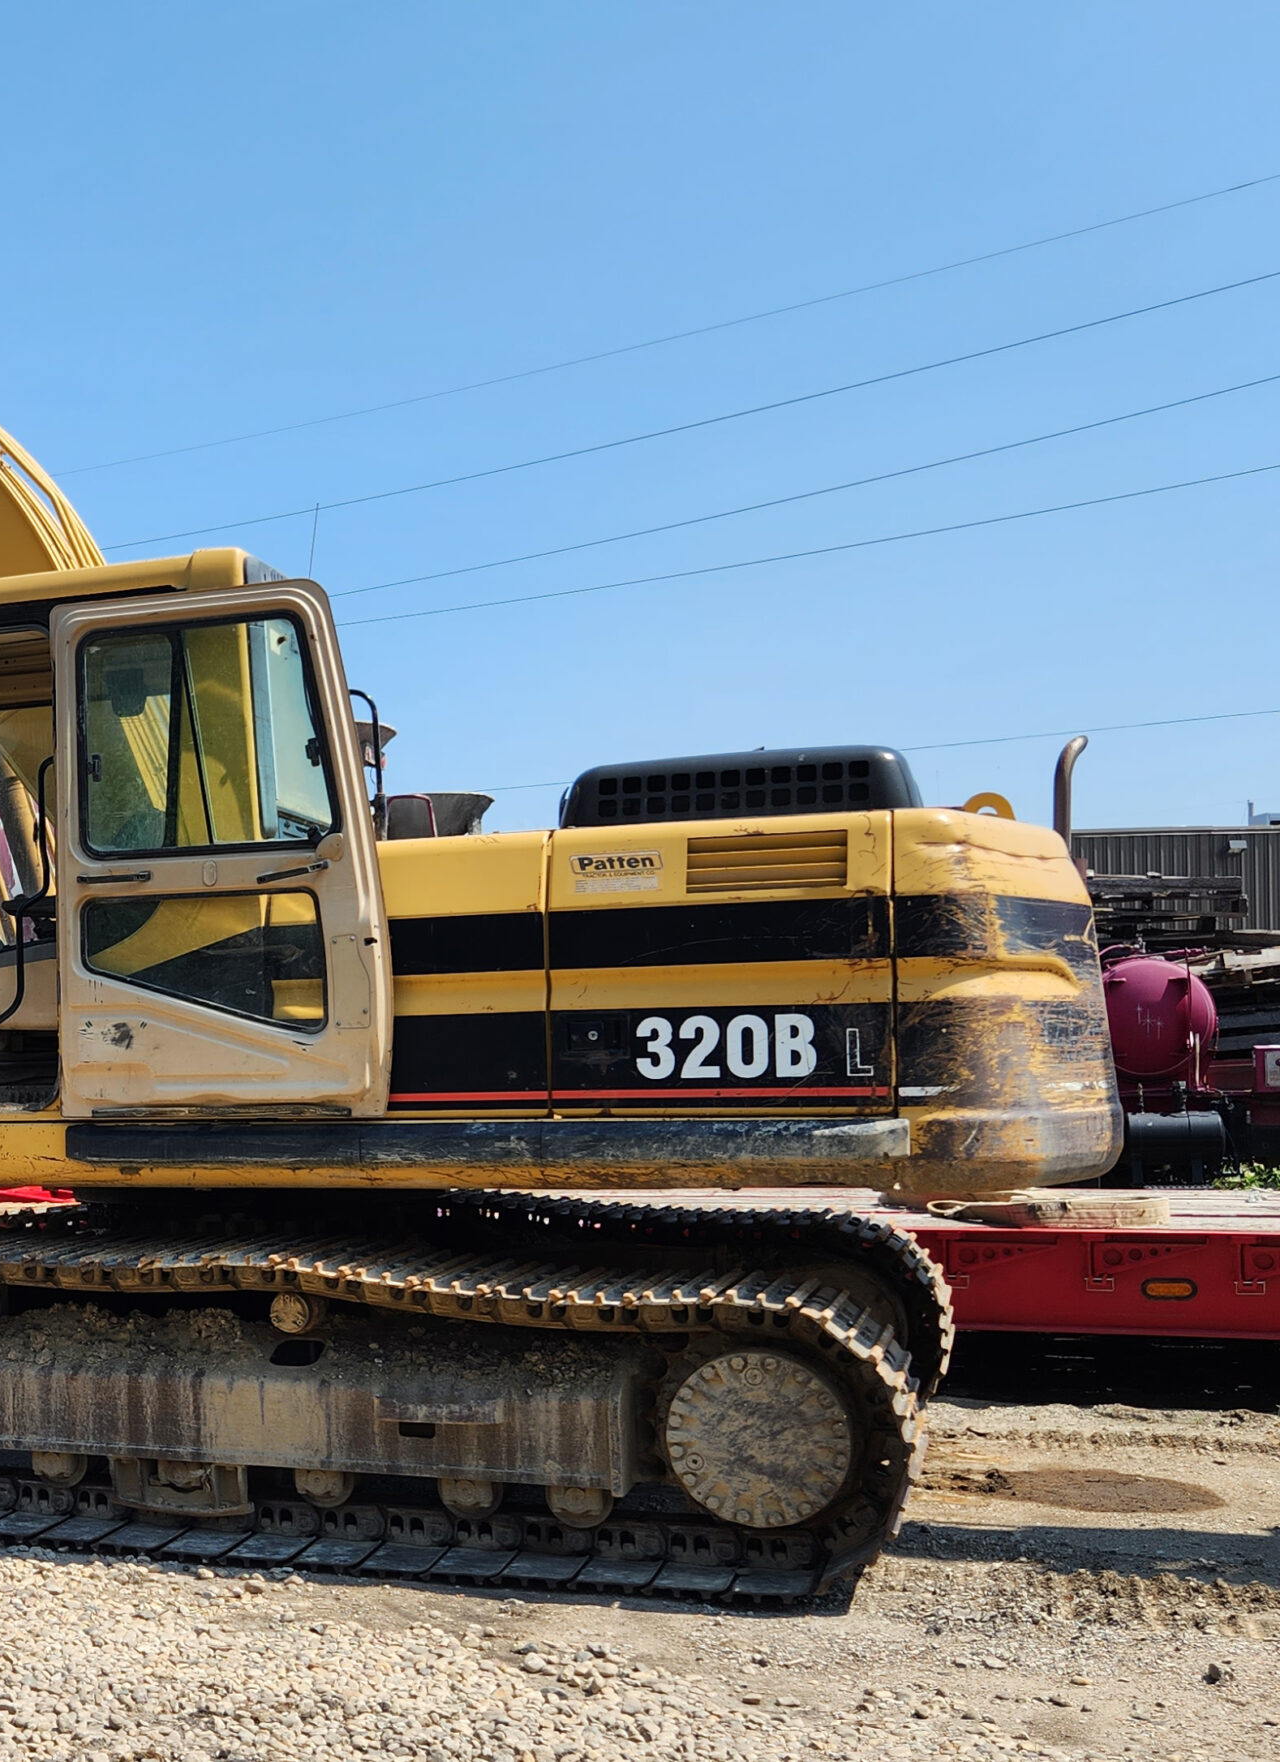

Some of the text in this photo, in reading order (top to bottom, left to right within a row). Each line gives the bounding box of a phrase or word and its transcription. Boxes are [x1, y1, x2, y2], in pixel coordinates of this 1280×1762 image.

[577, 856, 655, 871] Patten
[636, 1013, 874, 1080] 320B L
